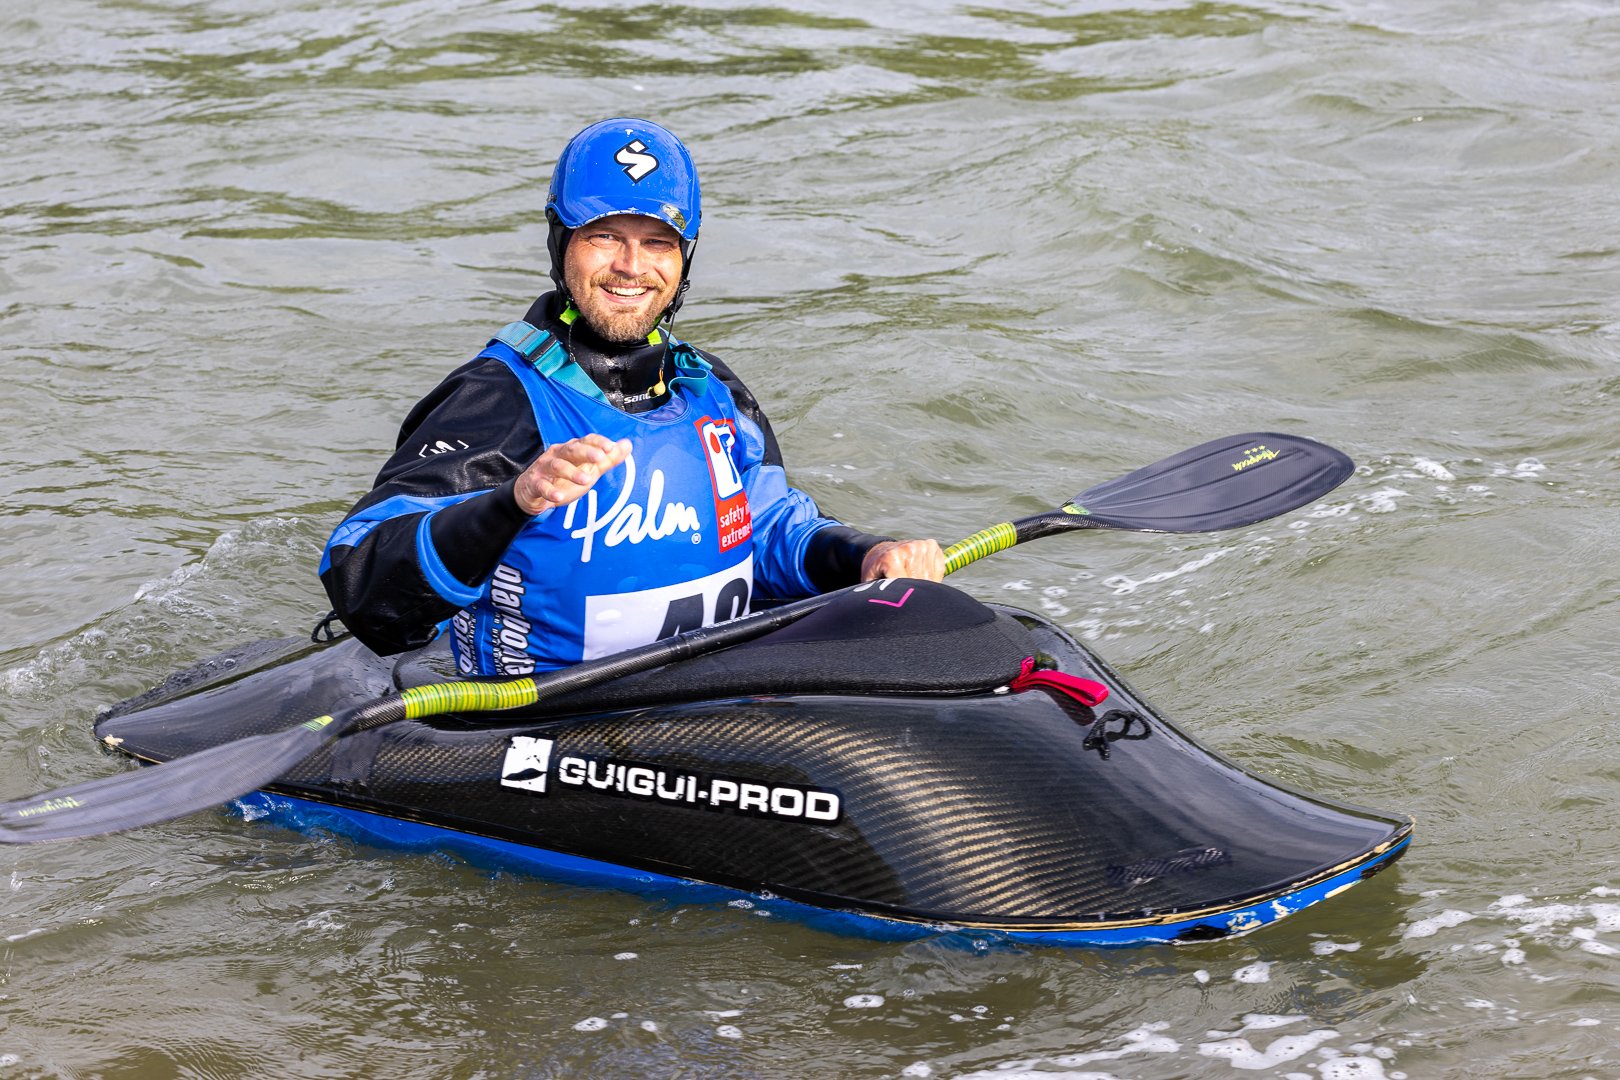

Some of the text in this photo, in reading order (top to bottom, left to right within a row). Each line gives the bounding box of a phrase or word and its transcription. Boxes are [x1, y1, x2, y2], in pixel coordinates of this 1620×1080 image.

[563, 453, 701, 563] Palm
[719, 504, 745, 528] safety
[558, 756, 840, 821] GUIGUI-PROD
